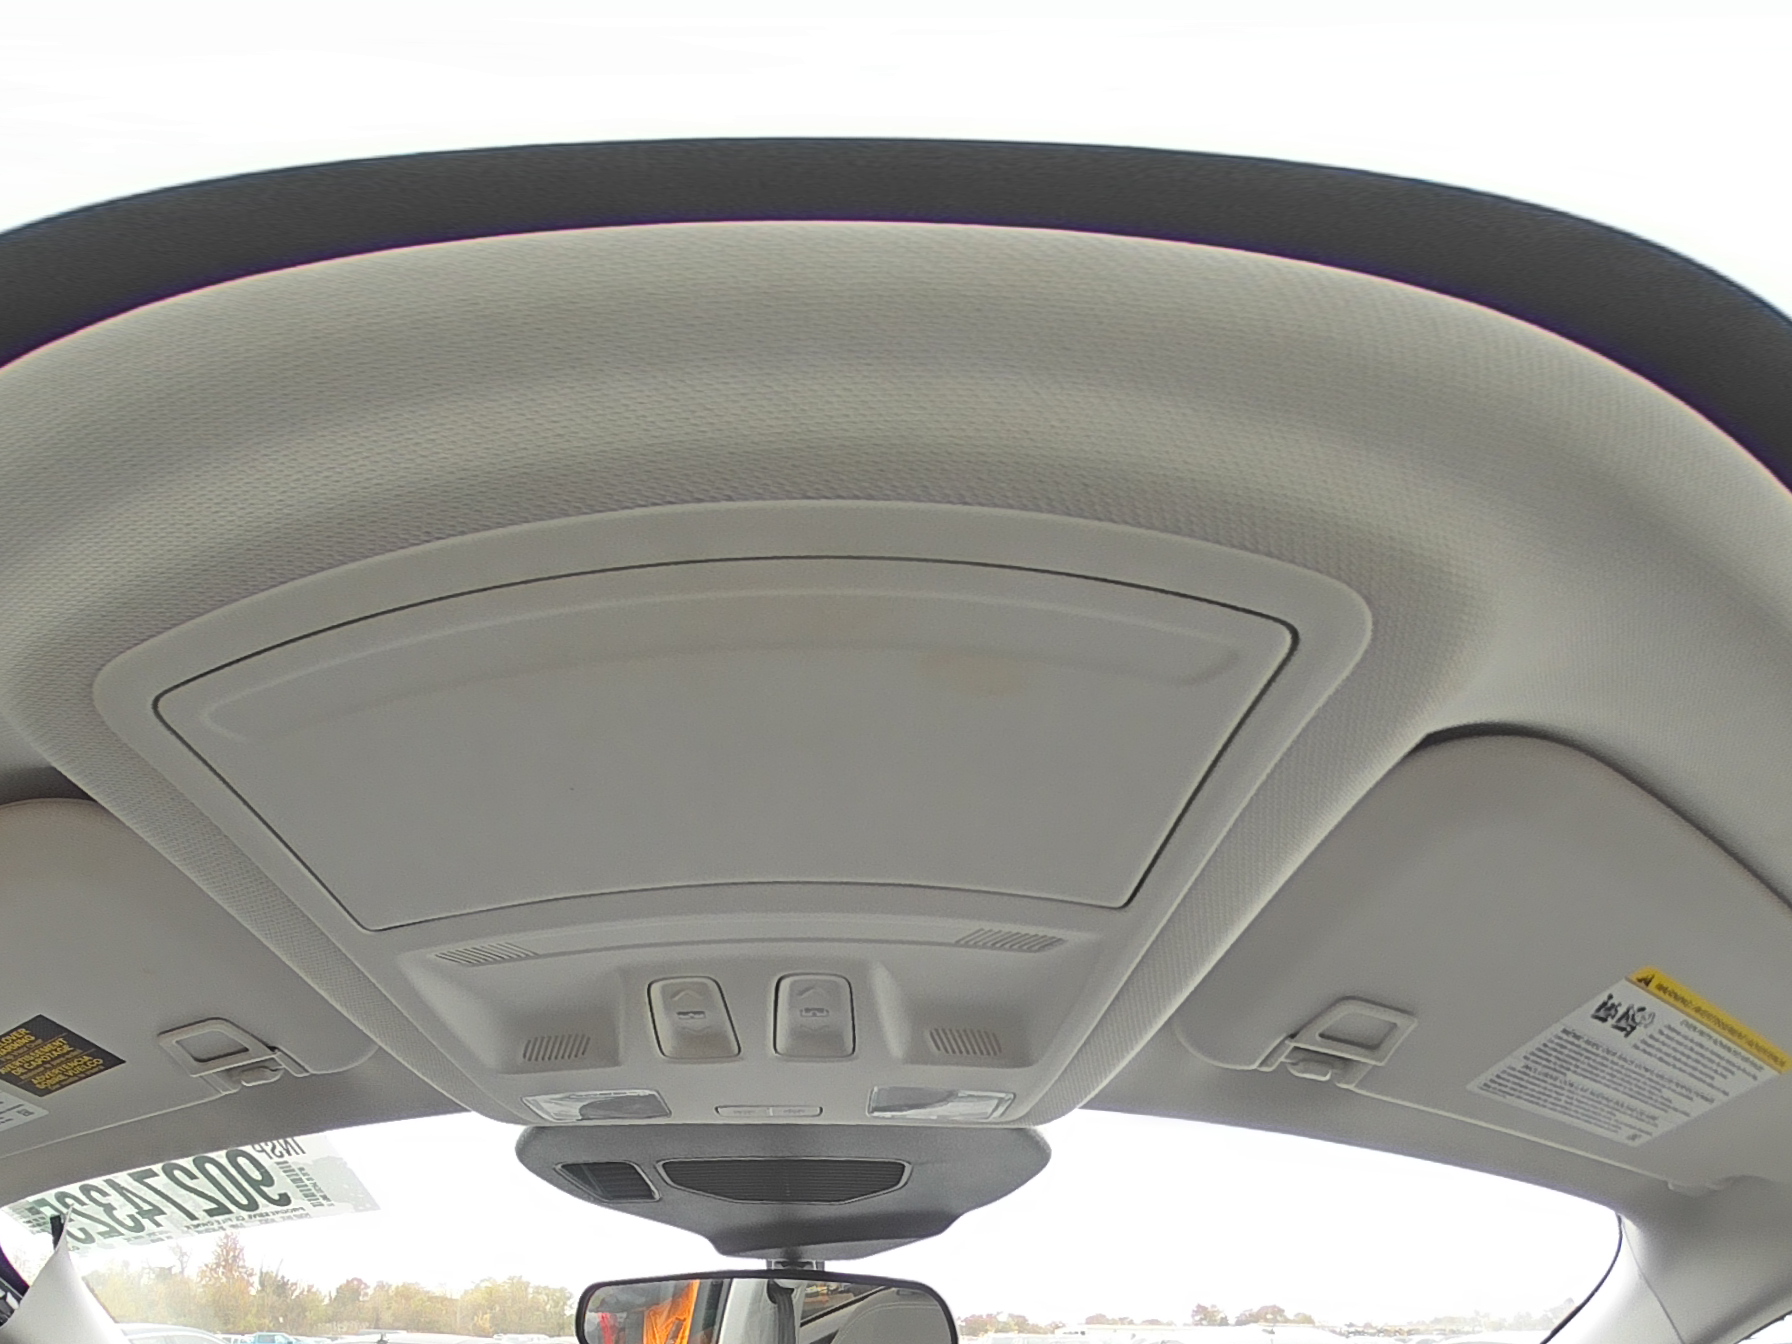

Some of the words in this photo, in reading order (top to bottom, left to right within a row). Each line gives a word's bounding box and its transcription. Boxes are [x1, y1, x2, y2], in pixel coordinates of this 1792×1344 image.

[23, 1045, 75, 1070] CAPOTAGE
[31, 1055, 93, 1085] ADVERTENCIA
[65, 1058, 104, 1077] VUELCO
